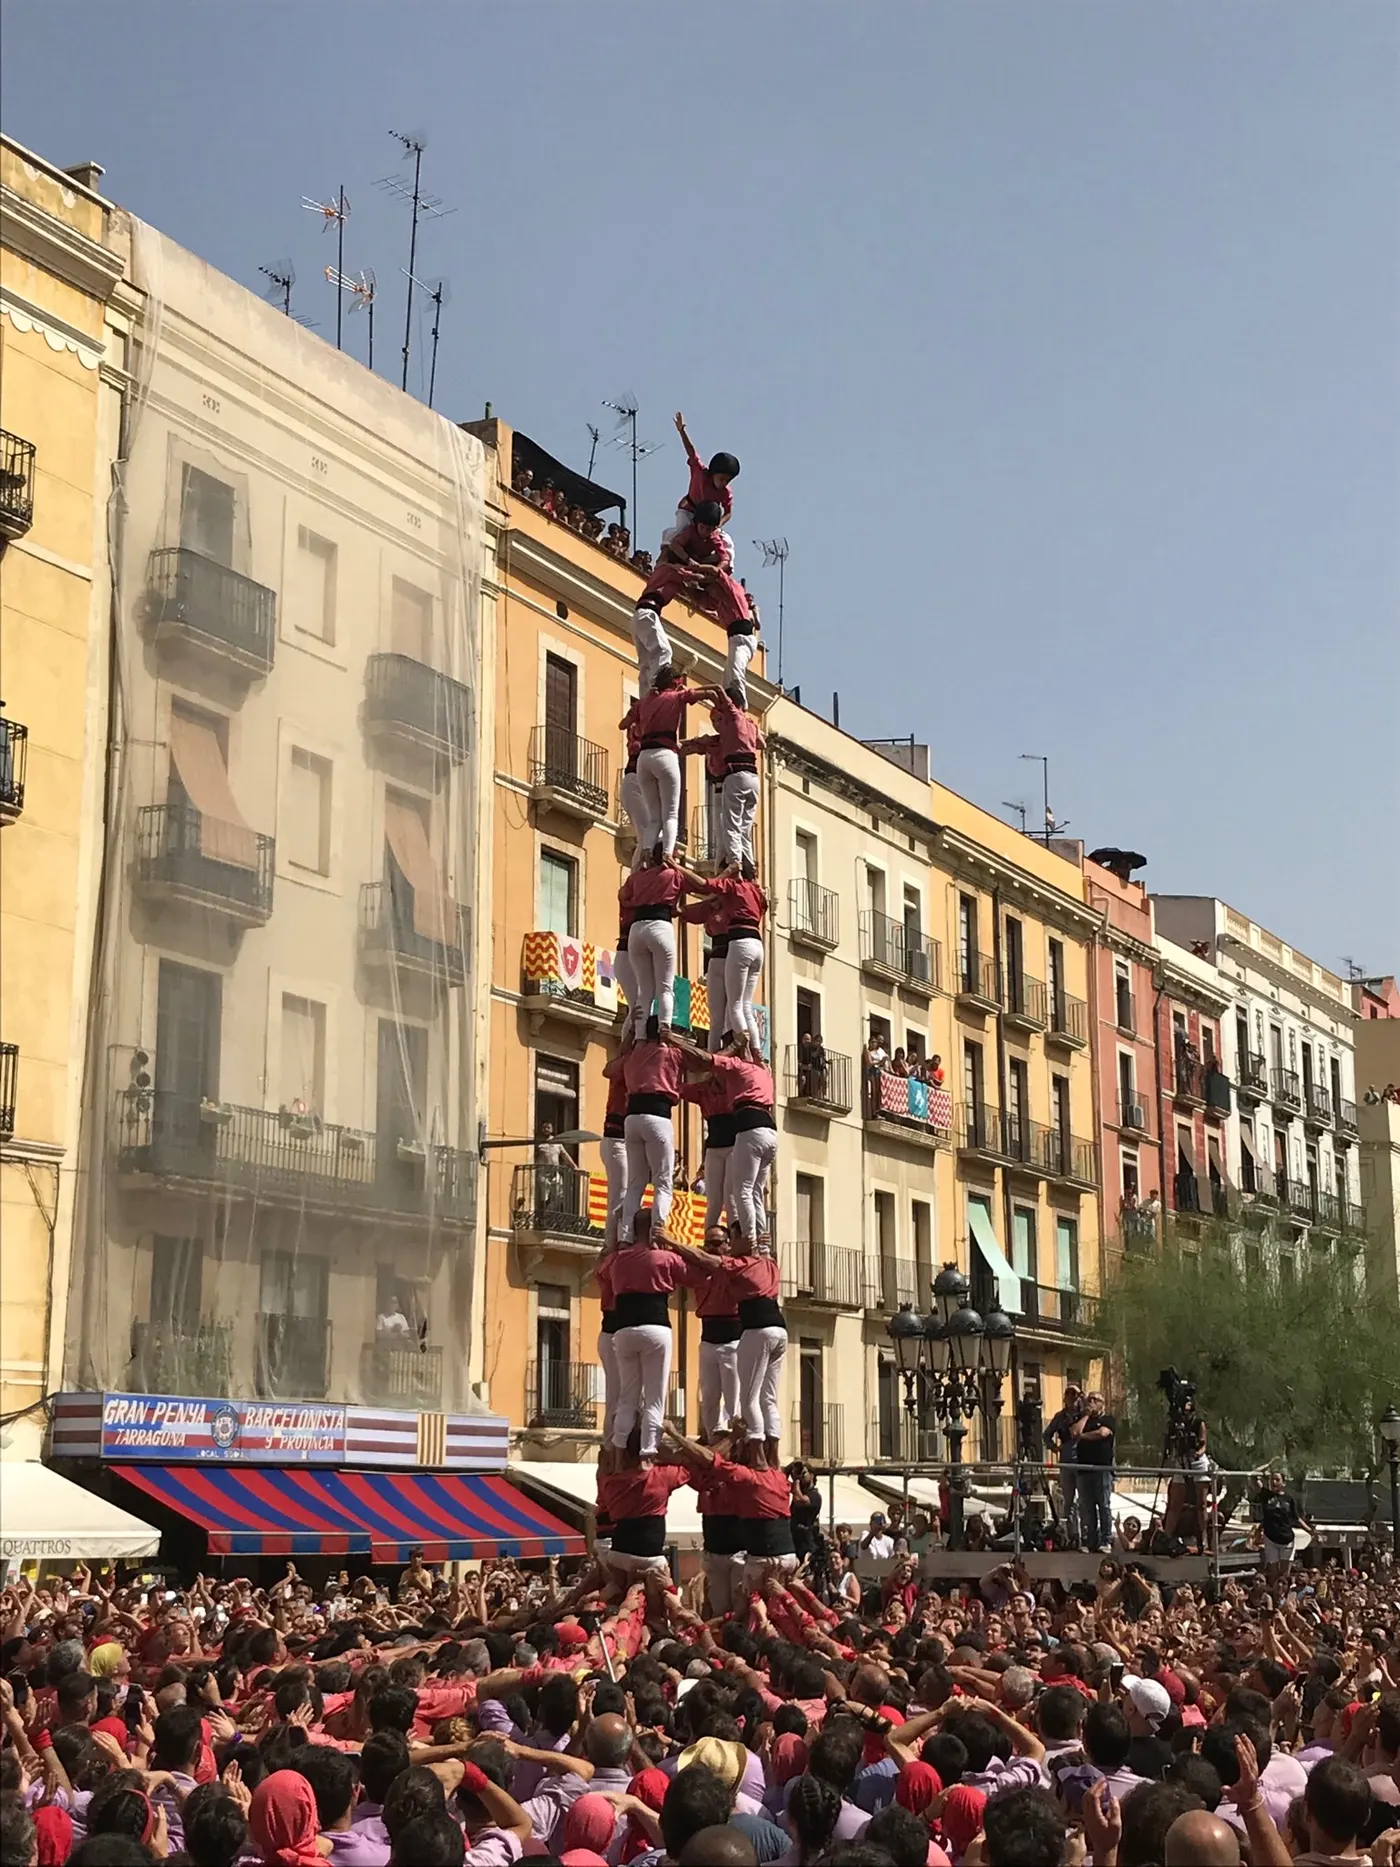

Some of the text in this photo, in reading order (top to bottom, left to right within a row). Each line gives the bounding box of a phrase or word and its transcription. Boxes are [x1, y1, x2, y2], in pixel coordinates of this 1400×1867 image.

[104, 1399, 150, 1426] GRAN
[151, 1401, 207, 1425] PENYA
[244, 1406, 344, 1431] BARCELONISTA
[114, 1428, 186, 1446] TARRAGONA
[3, 1539, 71, 1557] QUATTROS
